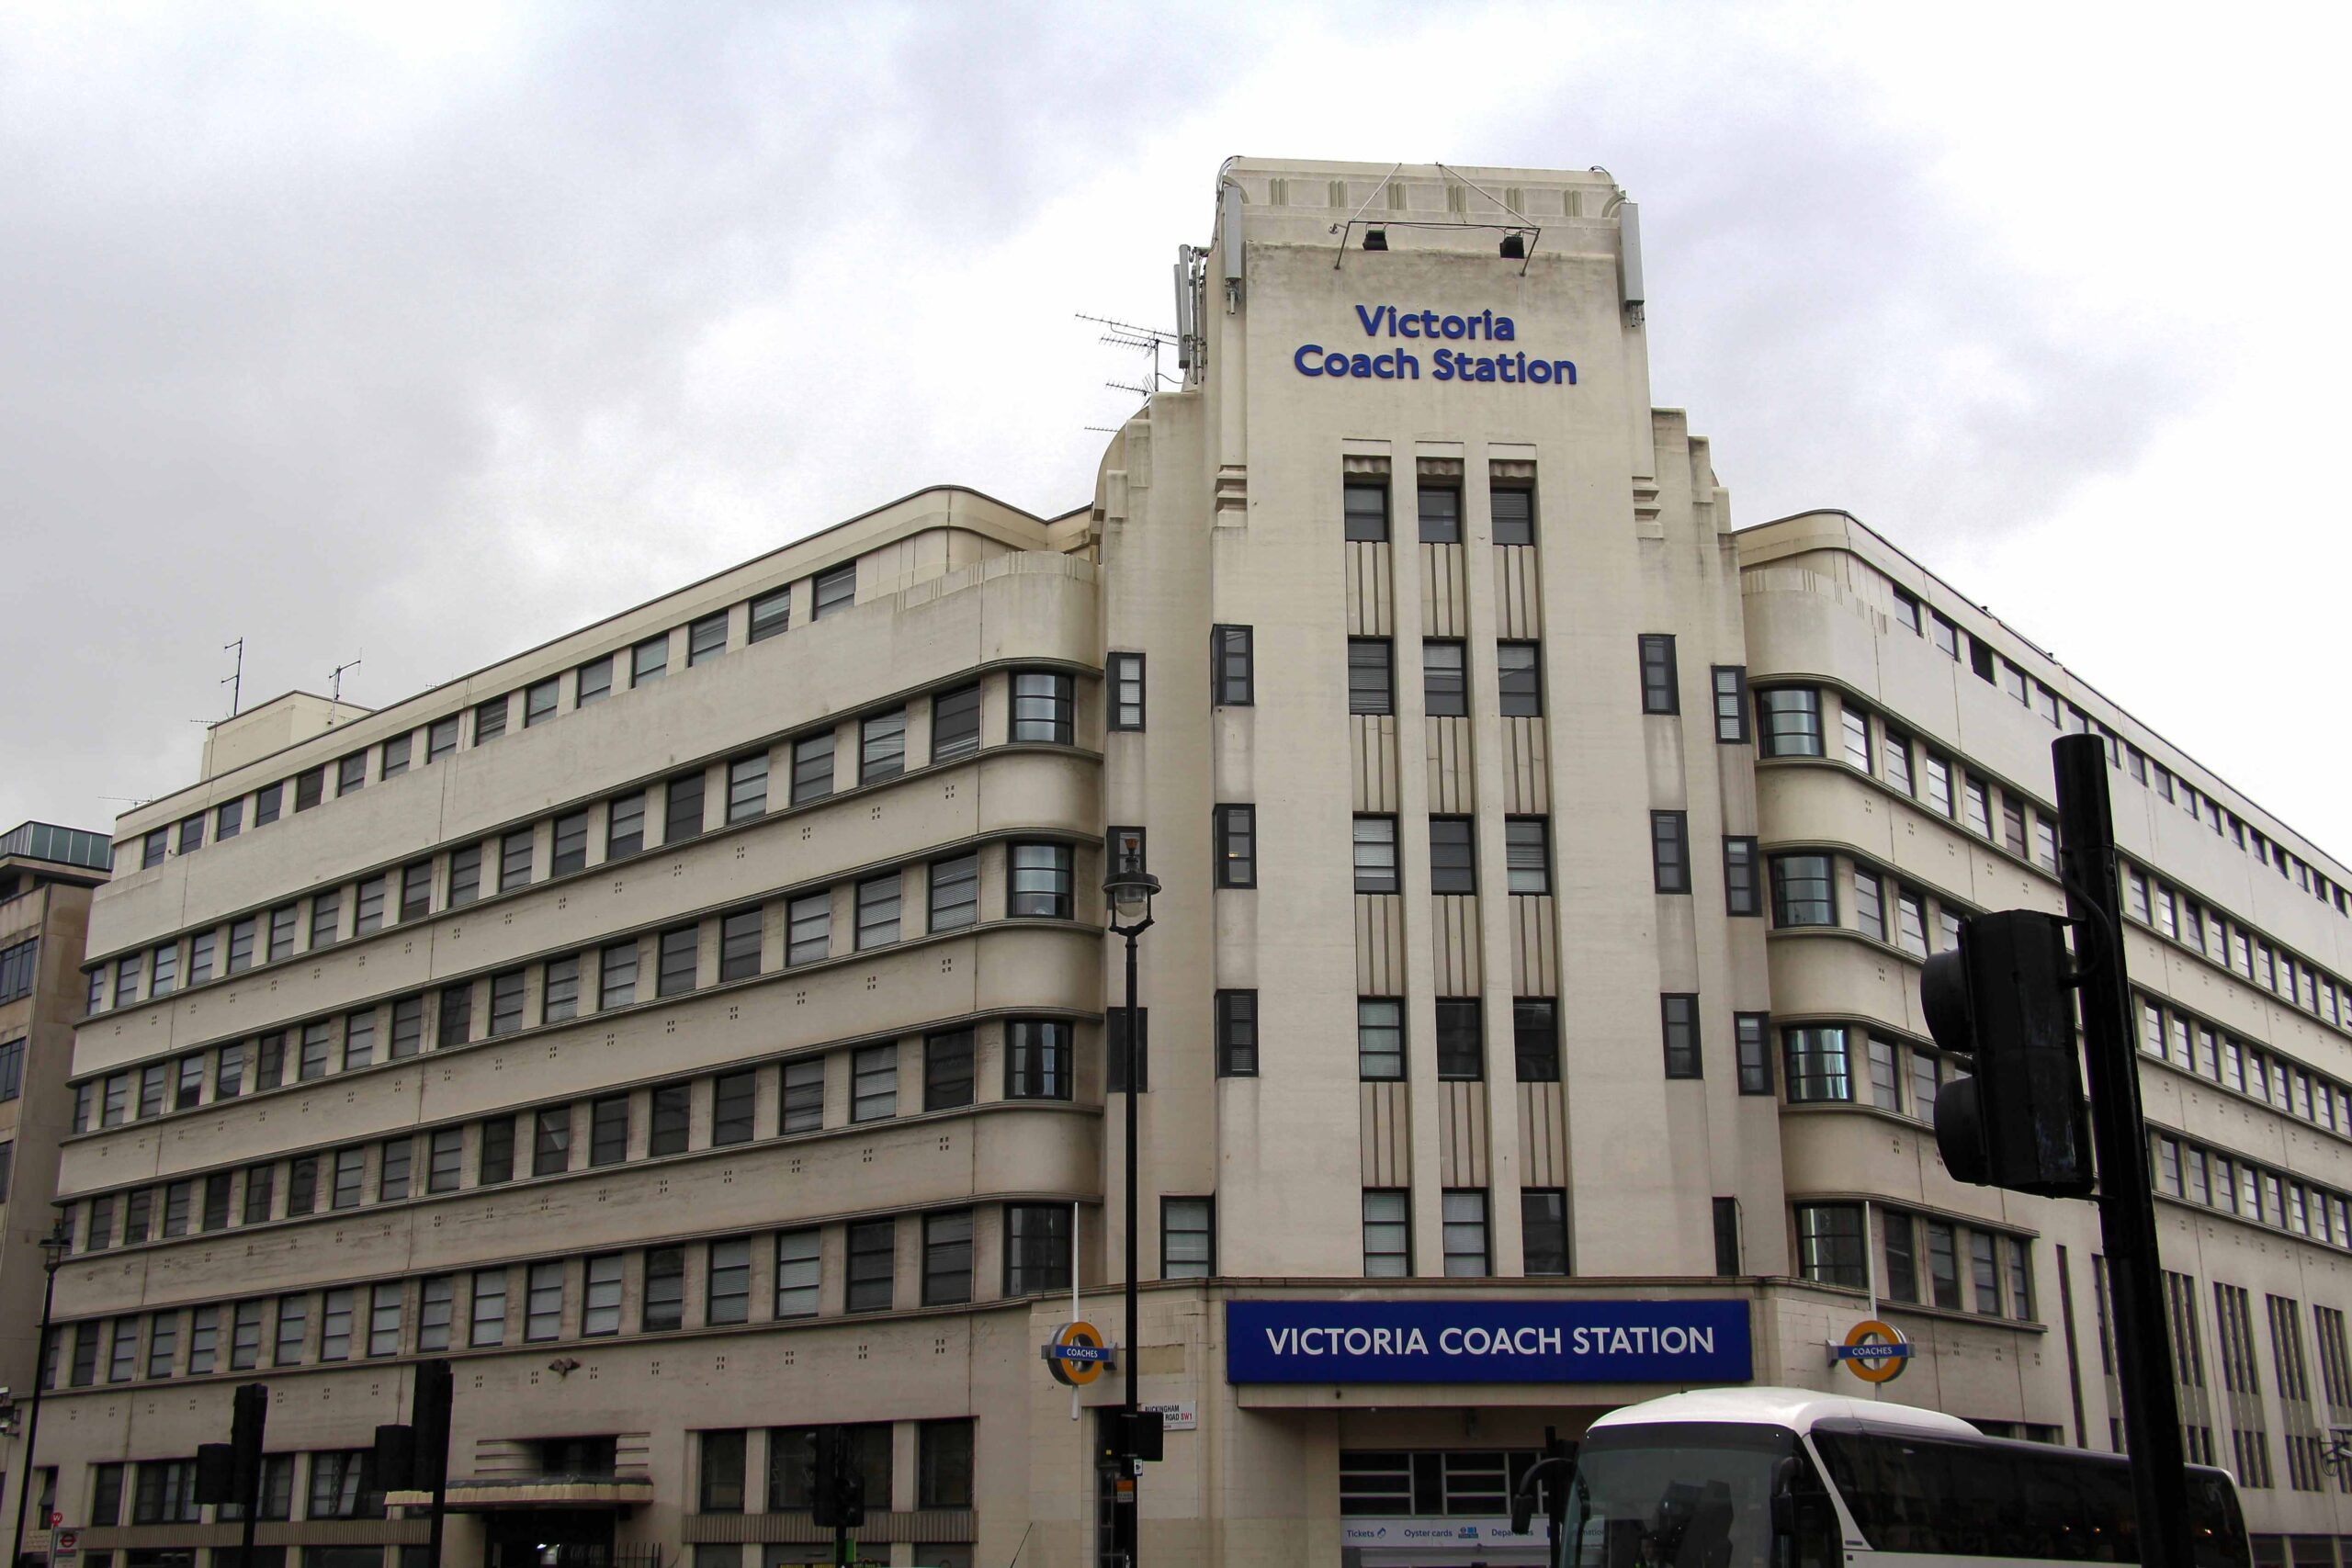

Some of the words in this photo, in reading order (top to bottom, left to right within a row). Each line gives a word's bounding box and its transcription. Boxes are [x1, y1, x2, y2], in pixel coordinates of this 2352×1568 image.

[1356, 305, 1515, 341] Victoria
[1295, 344, 1420, 379] Coach
[1432, 349, 1577, 385] Station
[1266, 1328, 1429, 1355] VICTORIA
[1440, 1328, 1561, 1355] COACH
[1574, 1327, 1714, 1355] STATION
[1067, 1348, 1099, 1359] COACHES
[1852, 1347, 1893, 1356] COACHES
[1145, 1404, 1180, 1414] BUCKINGHAM
[1165, 1413, 1180, 1421] ROAD
[1181, 1413, 1193, 1421] SW1
[1347, 1529, 1375, 1538] Tickets
[1404, 1529, 1431, 1538] Oyster
[1432, 1529, 1453, 1538] cards
